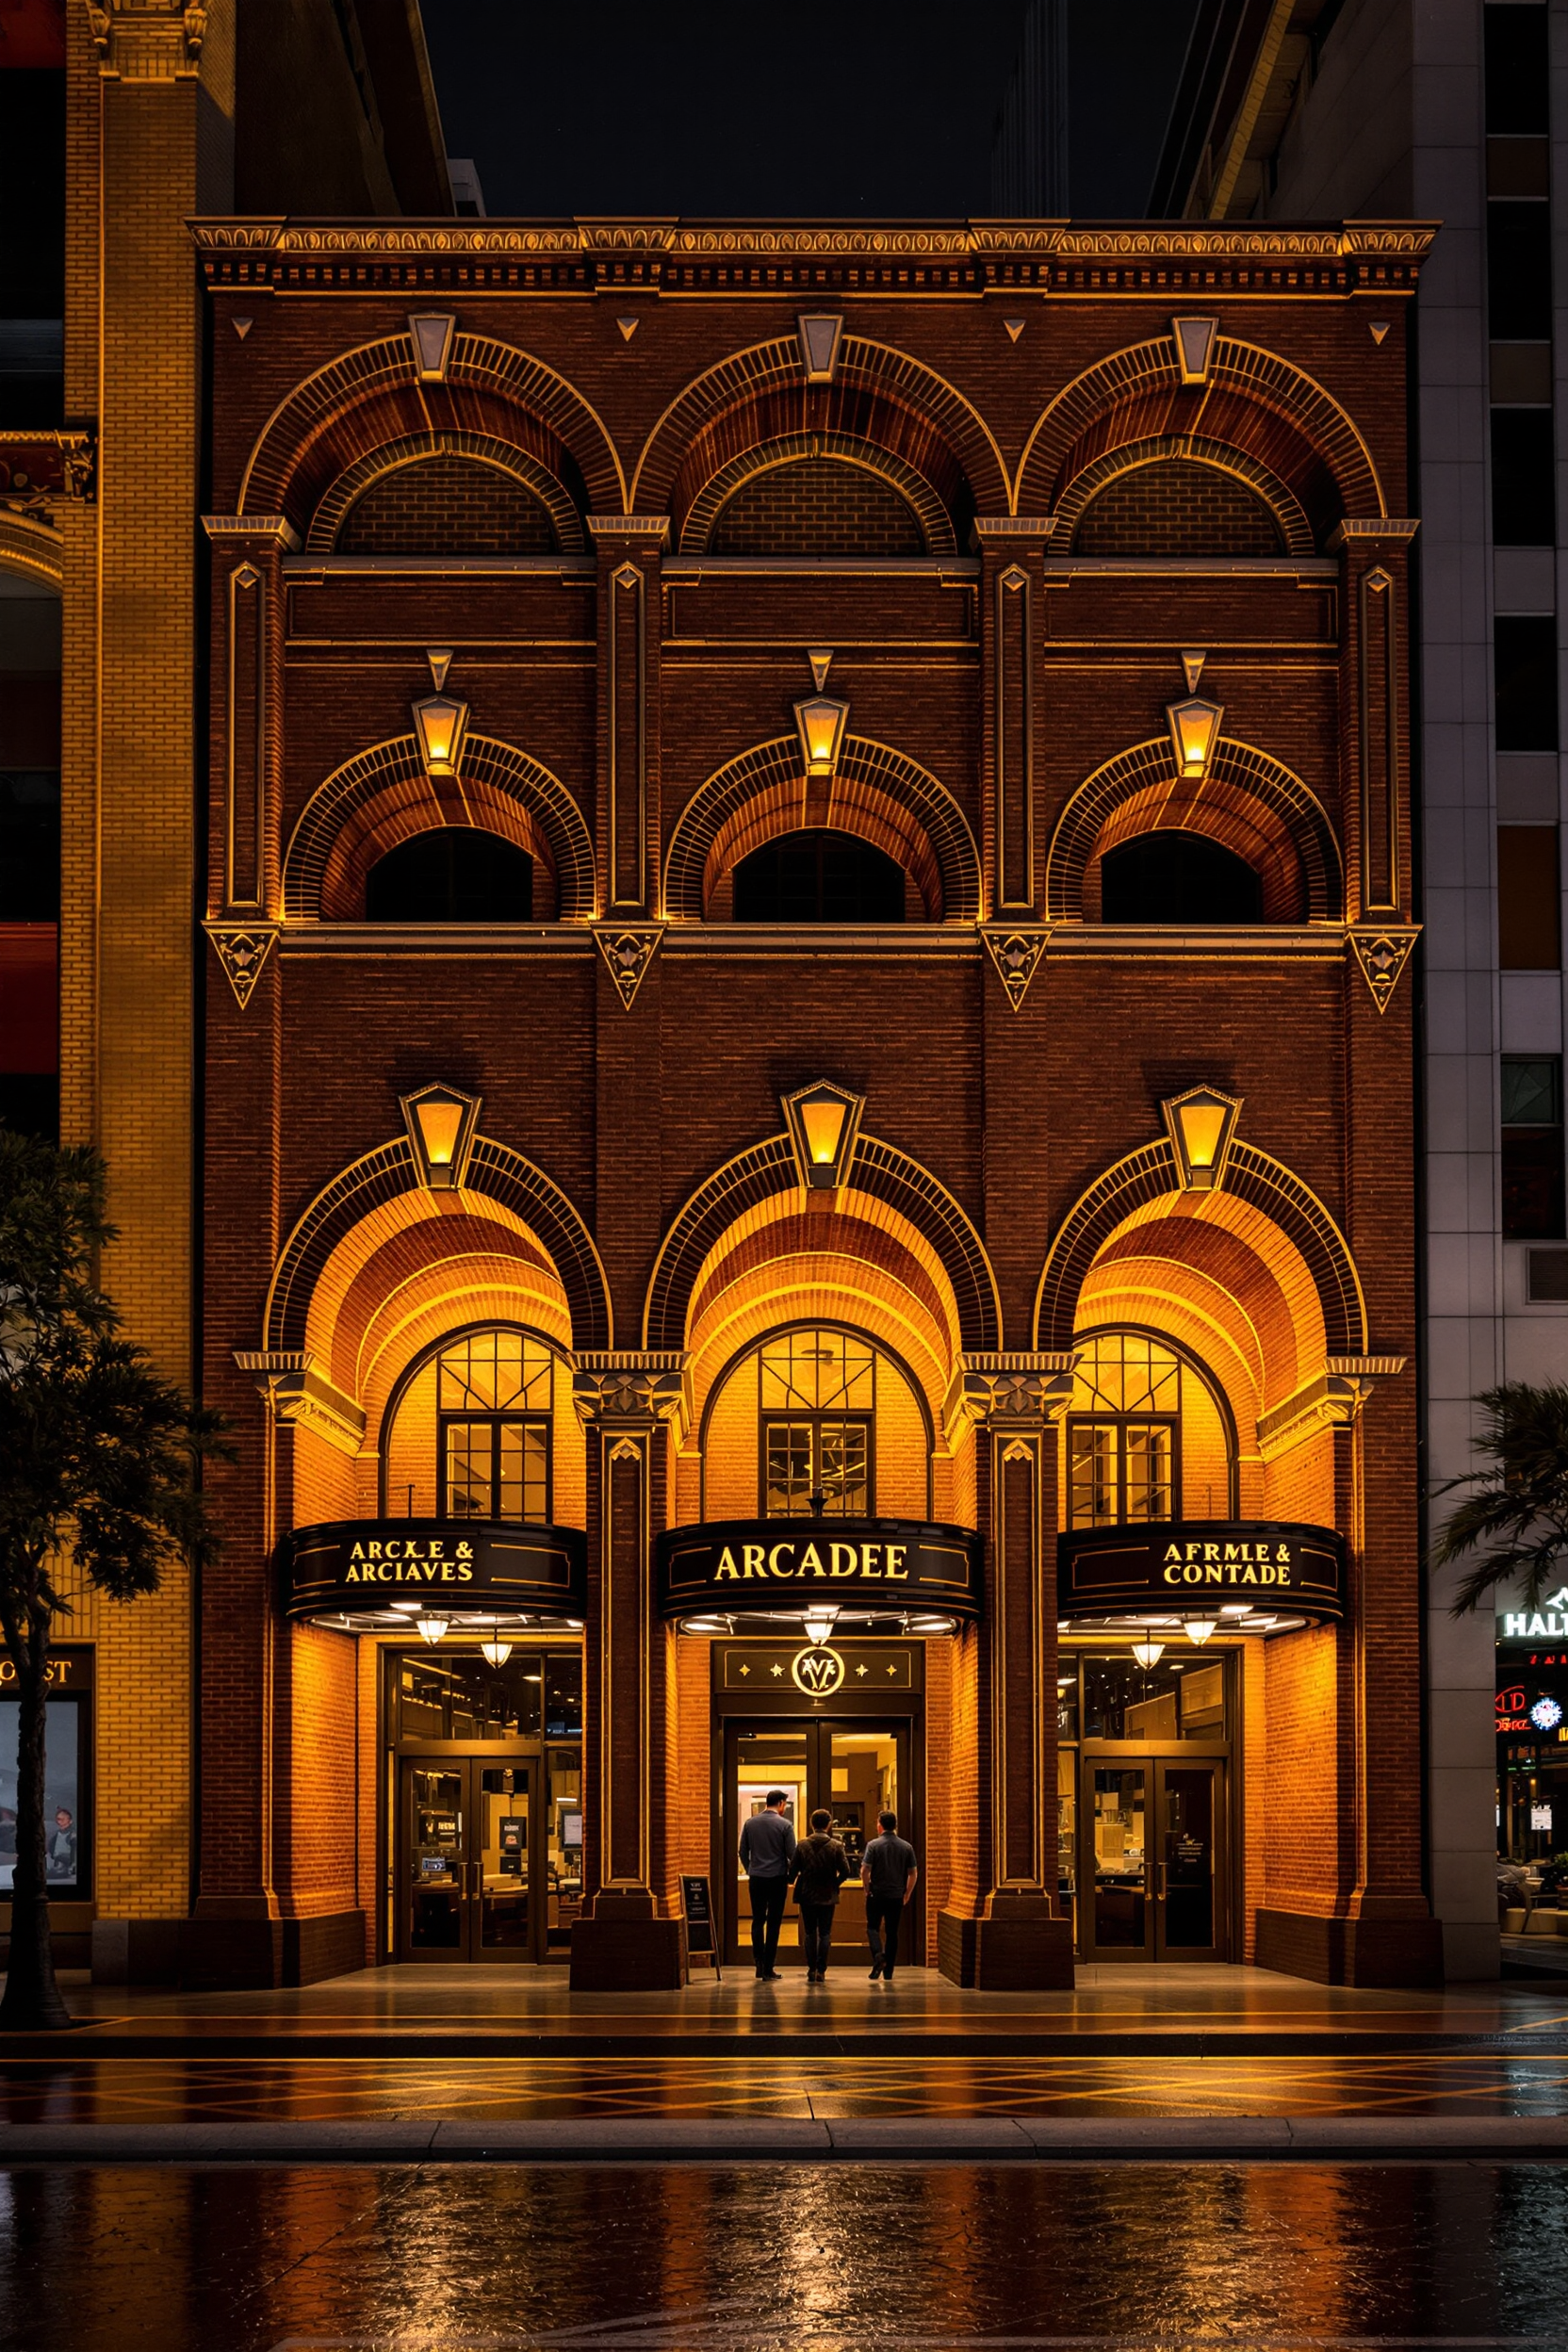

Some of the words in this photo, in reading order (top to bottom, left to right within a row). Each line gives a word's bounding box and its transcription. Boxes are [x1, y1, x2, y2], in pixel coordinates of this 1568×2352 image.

[455, 1541, 474, 1559] &
[1276, 1544, 1290, 1561] &
[713, 1543, 908, 1580] ARCADEE
[345, 1562, 473, 1582] ARCIAVES
[1164, 1564, 1291, 1585] CONTADE
